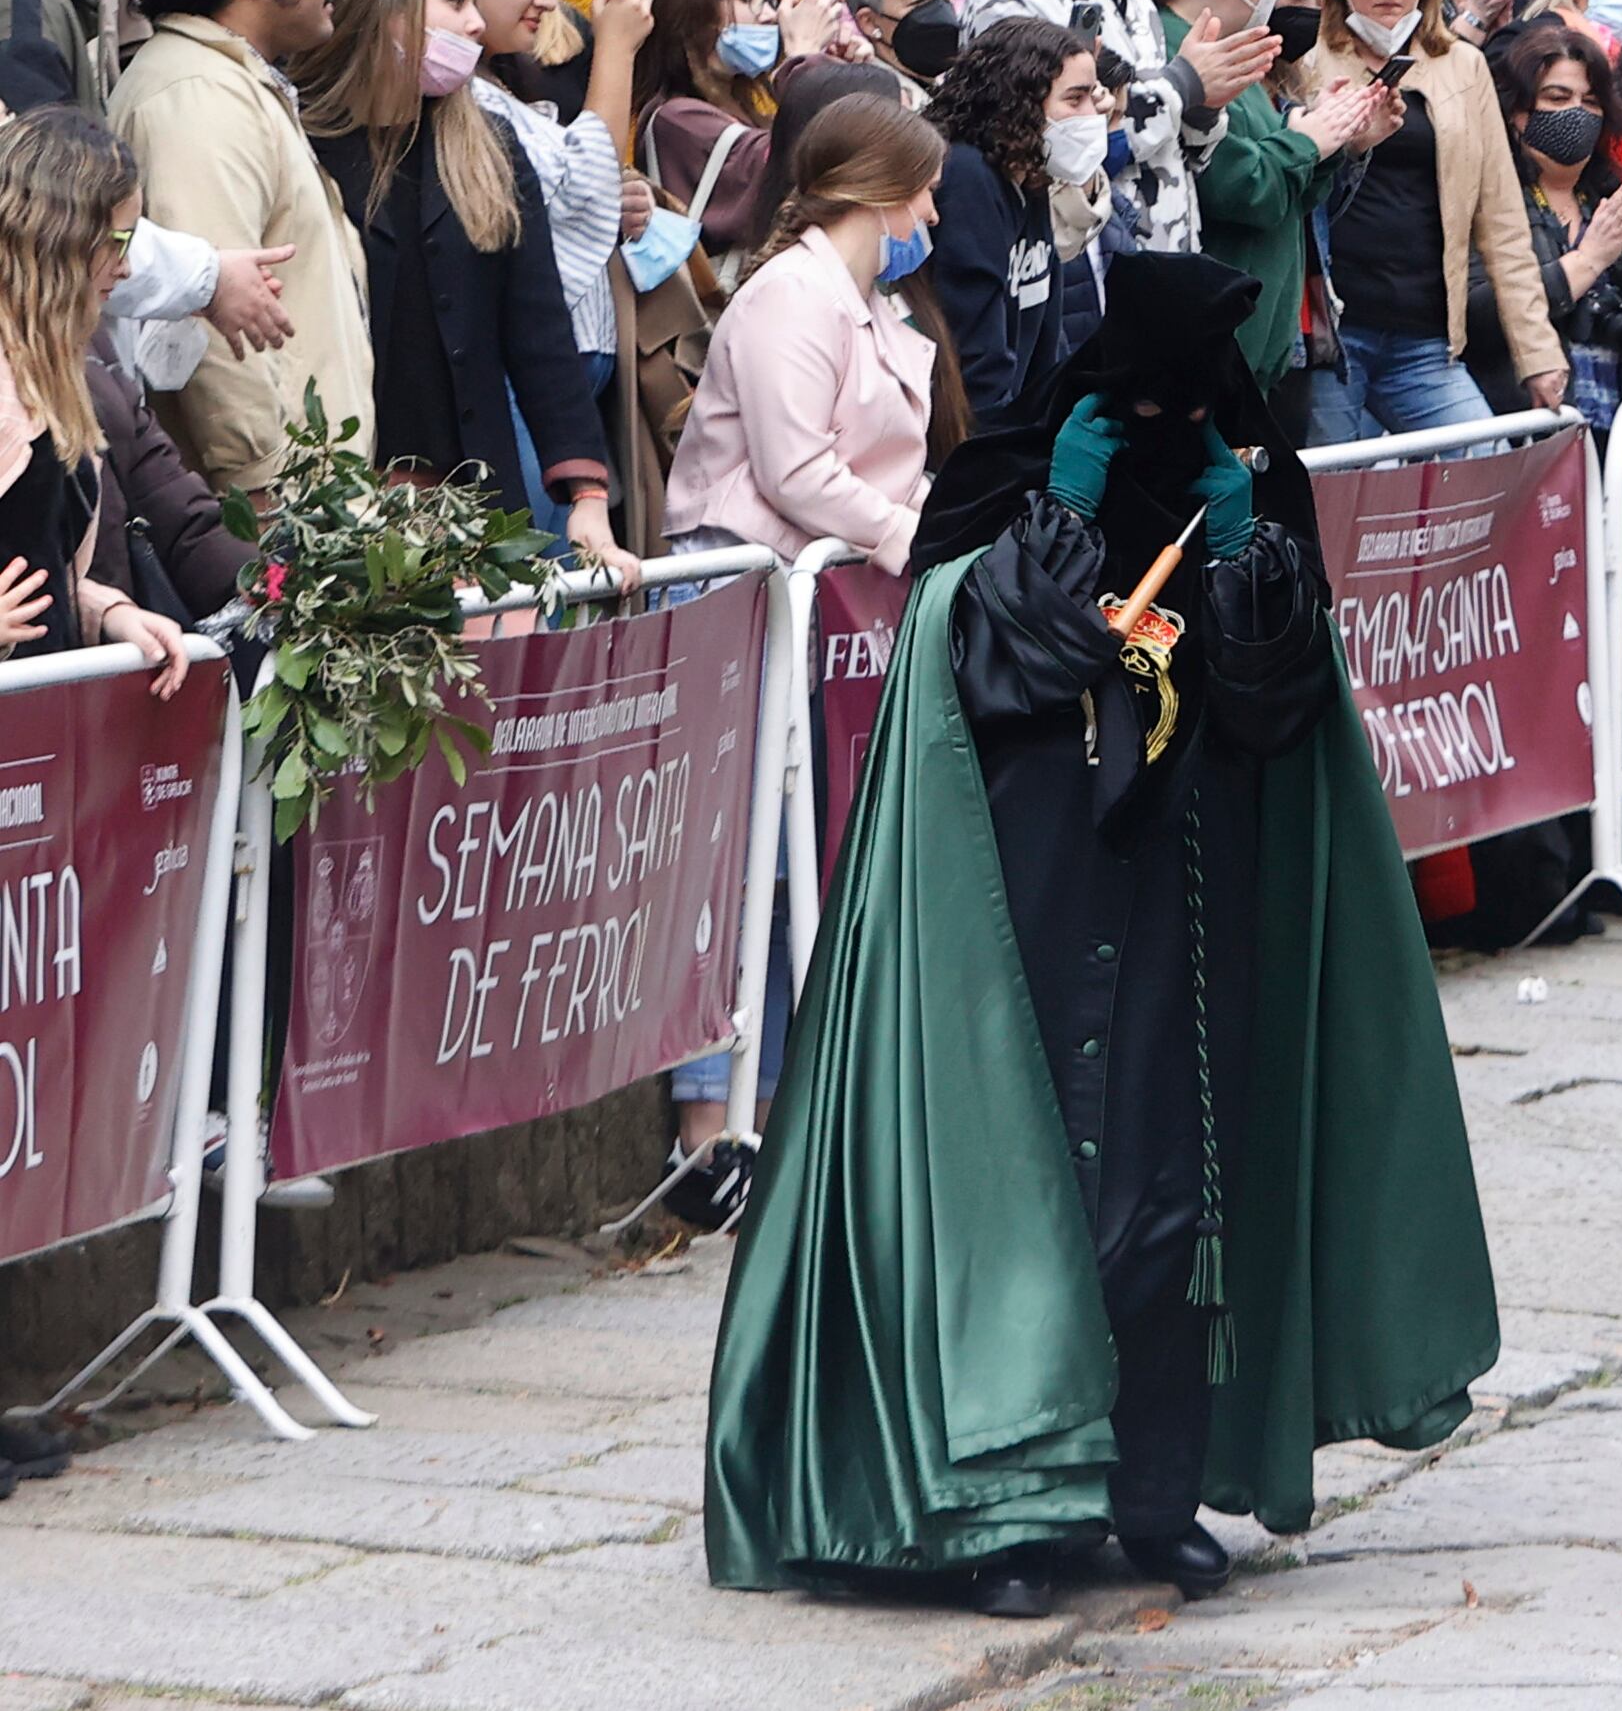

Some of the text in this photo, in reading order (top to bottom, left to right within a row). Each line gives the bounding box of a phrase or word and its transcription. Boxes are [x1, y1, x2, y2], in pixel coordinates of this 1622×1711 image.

[1330, 563, 1520, 690] EMANA SANTA
[1392, 680, 1516, 792] FERROL
[0, 782, 44, 828] ACIONAL
[417, 782, 602, 926] SEMANA
[0, 864, 82, 1013] NTA
[435, 900, 653, 1067] DE FERROL
